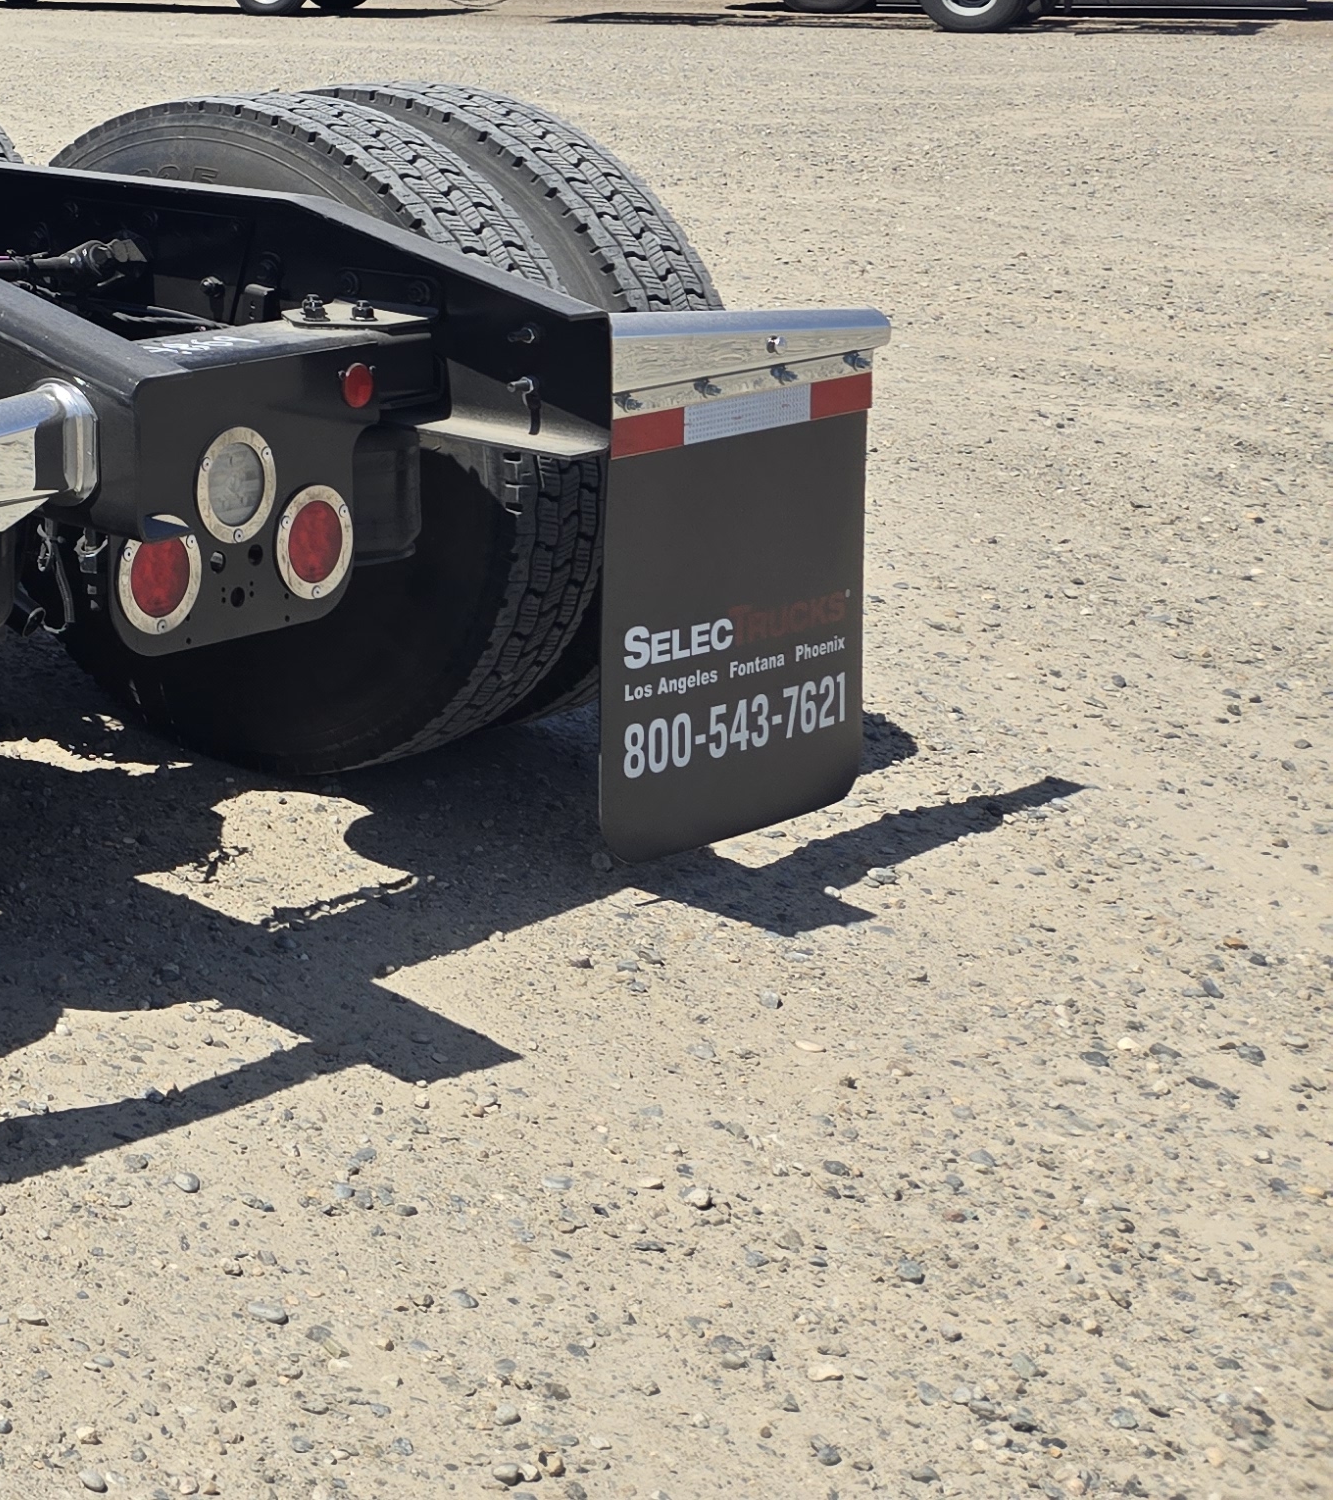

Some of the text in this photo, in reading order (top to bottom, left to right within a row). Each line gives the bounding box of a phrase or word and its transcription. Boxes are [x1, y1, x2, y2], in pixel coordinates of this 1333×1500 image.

[624, 635, 846, 702] Los Angeles Fontana Phoenix
[623, 671, 846, 779] 800-543-7621
